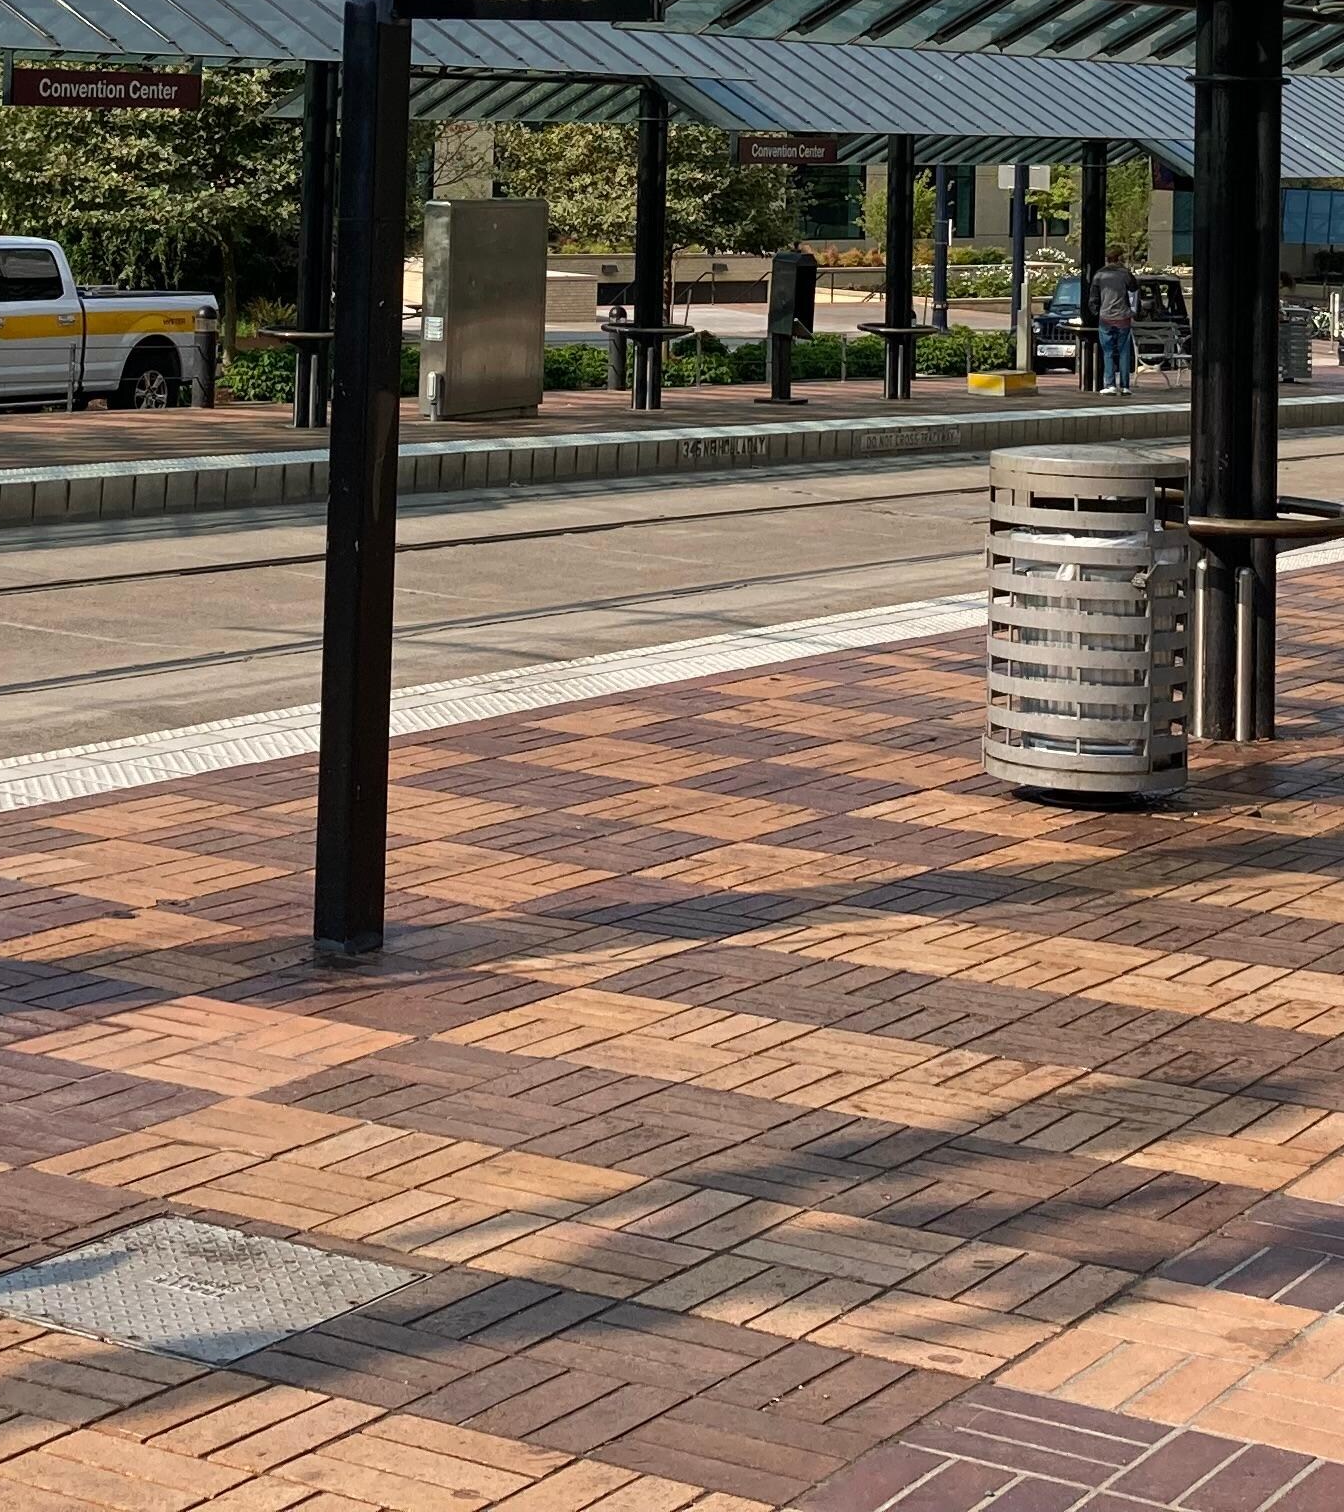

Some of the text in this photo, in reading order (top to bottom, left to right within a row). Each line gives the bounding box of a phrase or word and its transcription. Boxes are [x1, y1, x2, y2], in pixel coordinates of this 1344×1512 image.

[39, 78, 178, 100] Convention Center
[751, 143, 826, 158] Convention Center
